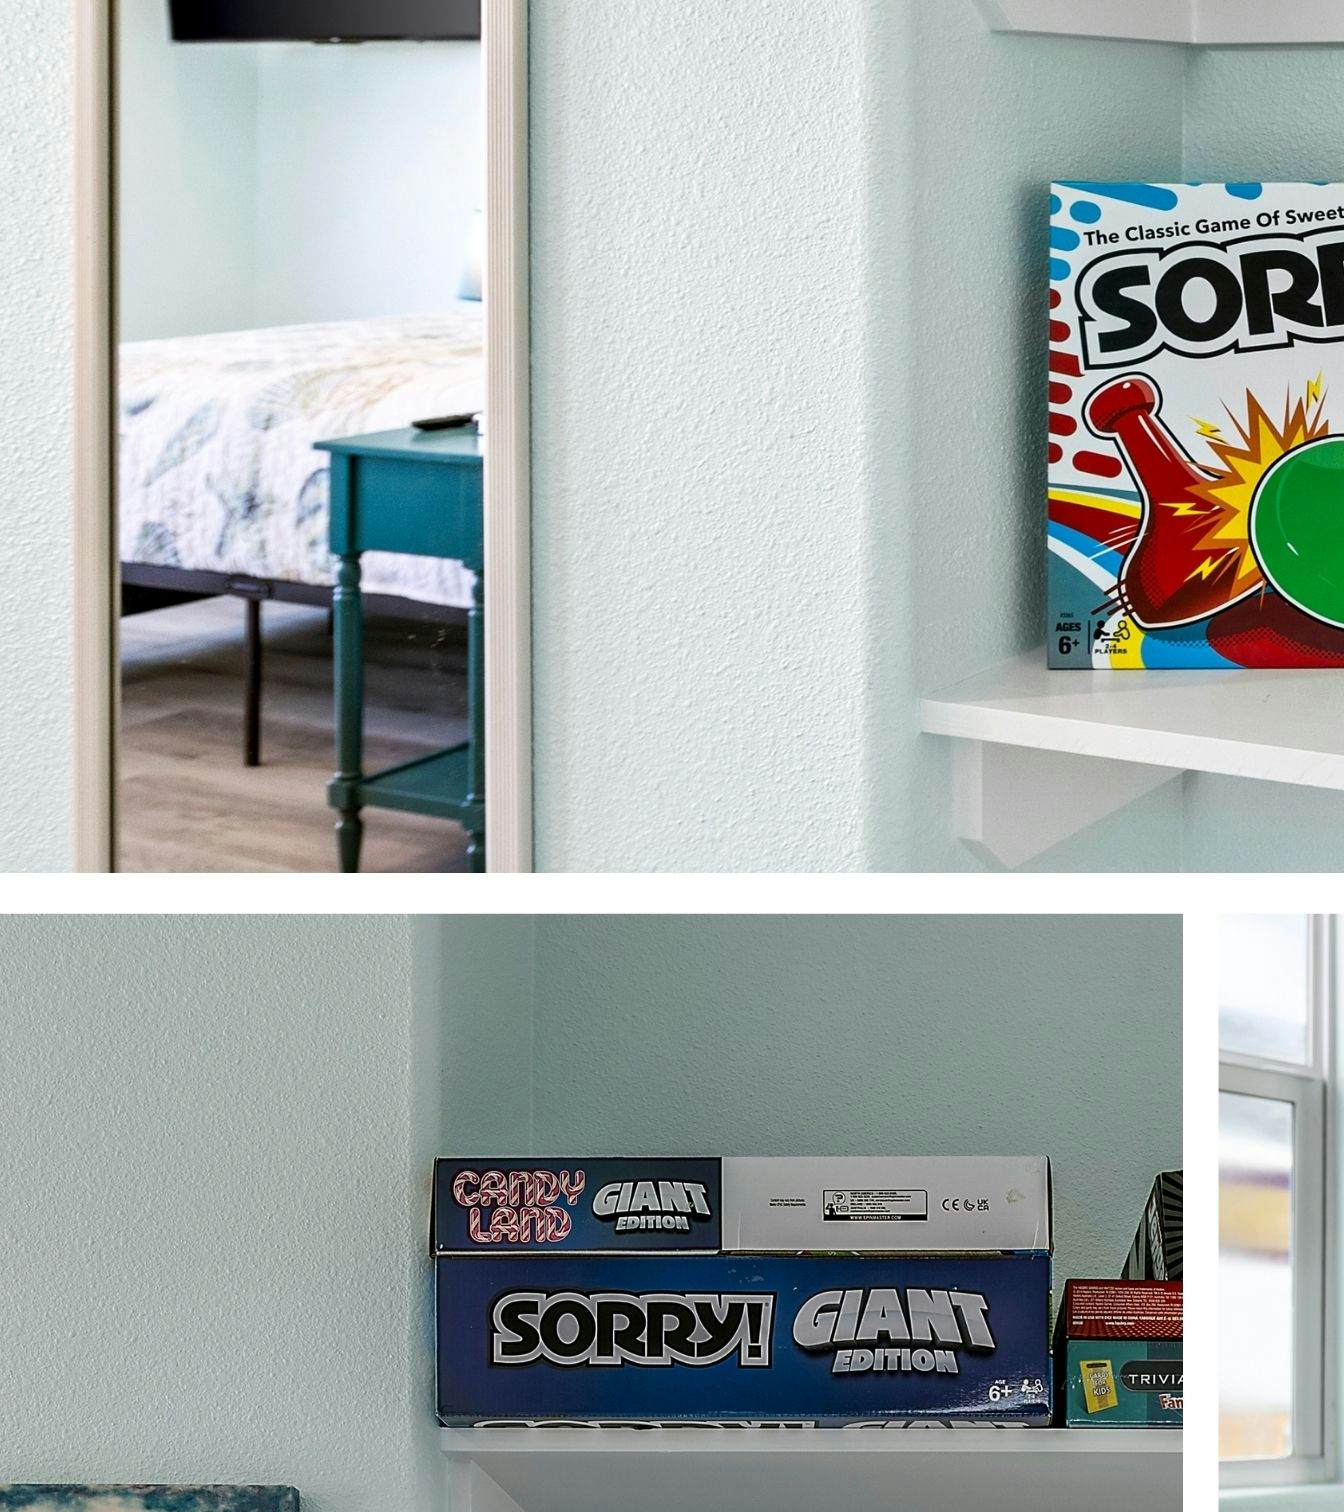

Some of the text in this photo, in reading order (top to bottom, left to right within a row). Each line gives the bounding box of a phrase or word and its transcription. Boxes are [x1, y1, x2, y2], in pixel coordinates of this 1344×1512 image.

[1083, 229, 1120, 246] The
[1125, 221, 1191, 242] Classic
[1195, 215, 1251, 234] Game
[1256, 210, 1280, 228] Of
[1055, 622, 1081, 632] AGES
[1058, 636, 1080, 655] 6+
[453, 1170, 585, 1207] CANDY
[592, 1181, 711, 1217] GIANT
[469, 1206, 572, 1242] LAND
[615, 1215, 690, 1231] EDITION
[498, 1299, 766, 1360] SORRY!
[793, 1288, 997, 1350] GIANT
[831, 1347, 960, 1374] EDITION
[988, 1385, 1012, 1402] 6+
[1093, 1387, 1110, 1396] KIDS
